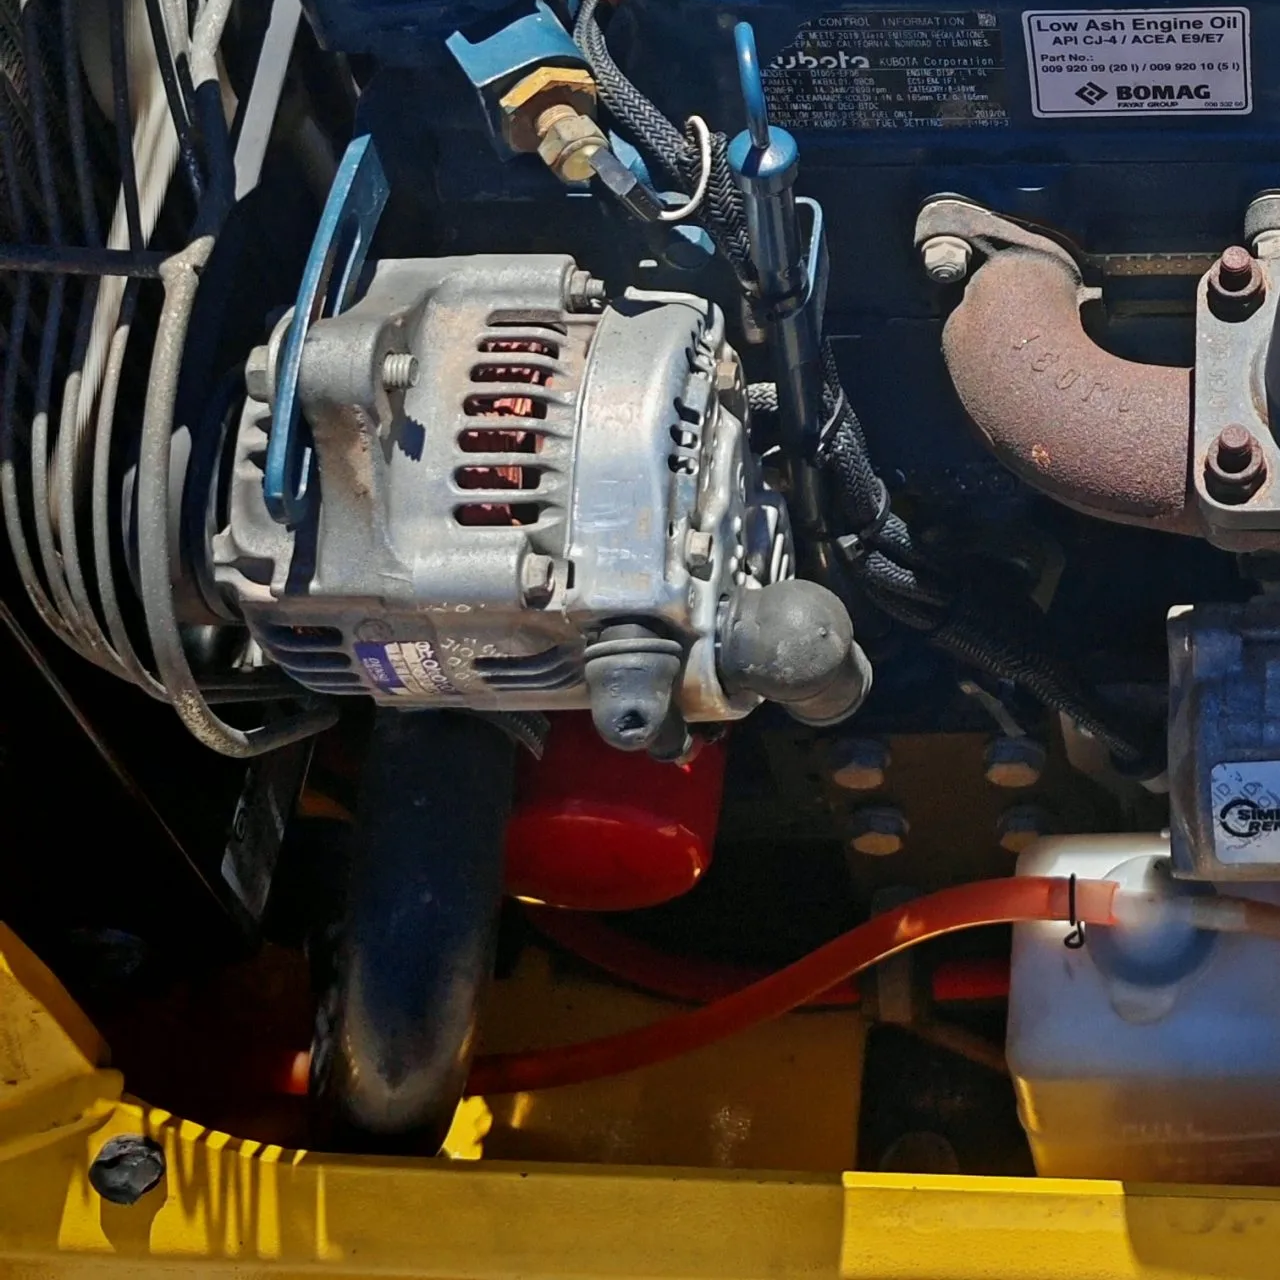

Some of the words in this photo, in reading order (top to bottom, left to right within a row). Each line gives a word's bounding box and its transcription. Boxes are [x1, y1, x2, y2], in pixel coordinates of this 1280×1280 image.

[819, 18, 870, 27] CONTROL
[882, 17, 965, 26] INFORMATION
[1036, 19, 1078, 32] Low
[1085, 18, 1125, 32] Ash
[1132, 17, 1204, 34] Engine
[1210, 16, 1238, 30] Oil
[809, 32, 834, 40] MEETS
[1052, 36, 1078, 46] API
[1082, 35, 1118, 46] CJ-4
[1121, 34, 1127, 44] /
[1131, 34, 1177, 44] ACEA
[1181, 33, 1224, 44] E9/E7
[816, 40, 832, 48] AND
[836, 40, 889, 48] CALIFORNIA
[879, 58, 918, 66] KUBOTA
[923, 56, 994, 67] Corporation
[1040, 54, 1066, 62] Part
[1074, 54, 1094, 62] No.:
[1041, 64, 1063, 73] 009
[1066, 64, 1088, 72] 920
[1091, 64, 1106, 72] 09
[1109, 64, 1128, 74] (20
[1150, 63, 1172, 72] 009
[1175, 62, 1197, 71] 920
[1201, 62, 1214, 70] 10
[1218, 62, 1229, 72] (5
[1116, 84, 1211, 100] BOMAG
[858, 102, 880, 110] BTDC
[871, 110, 889, 118] FUEL
[876, 120, 898, 128] FUEL
